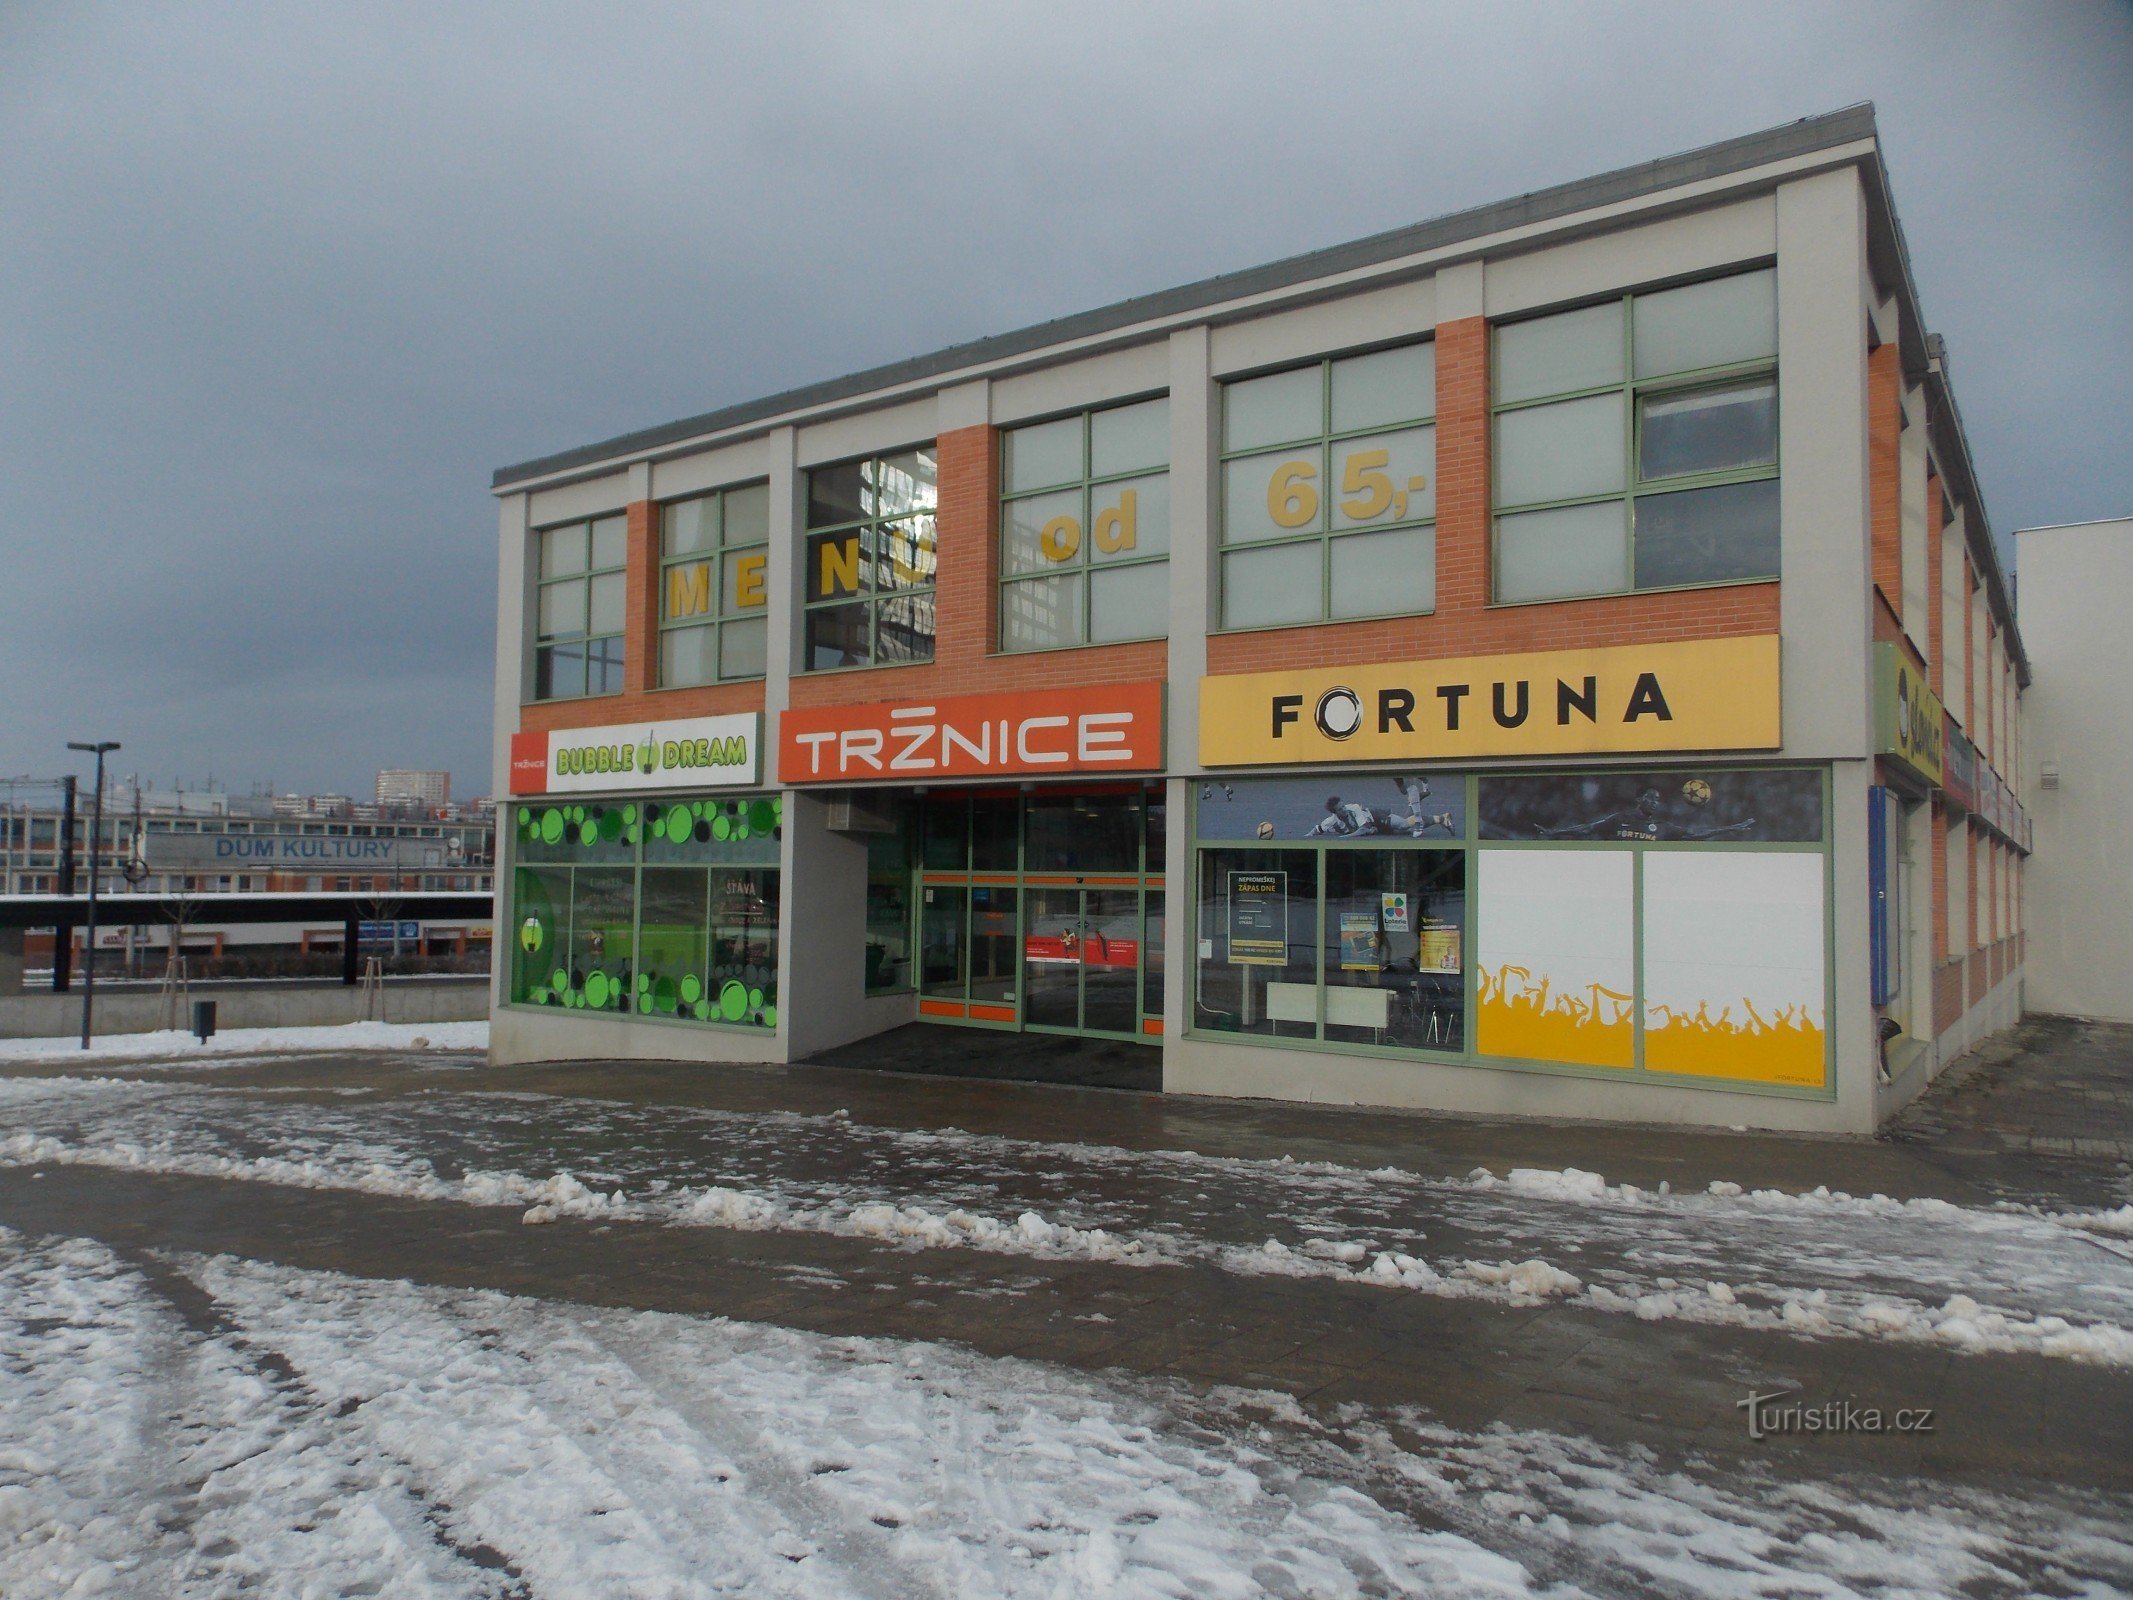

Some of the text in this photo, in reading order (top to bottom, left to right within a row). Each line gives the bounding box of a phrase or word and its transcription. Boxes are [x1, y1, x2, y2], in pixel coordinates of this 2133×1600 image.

[1040, 489, 1136, 561] od
[1267, 449, 1425, 528] 65,-
[796, 706, 1133, 773] TRŽNICE
[1272, 673, 1673, 742] FORTUNA
[556, 735, 747, 775] BUBBLE DREAM
[282, 839, 393, 858] KULTURY
